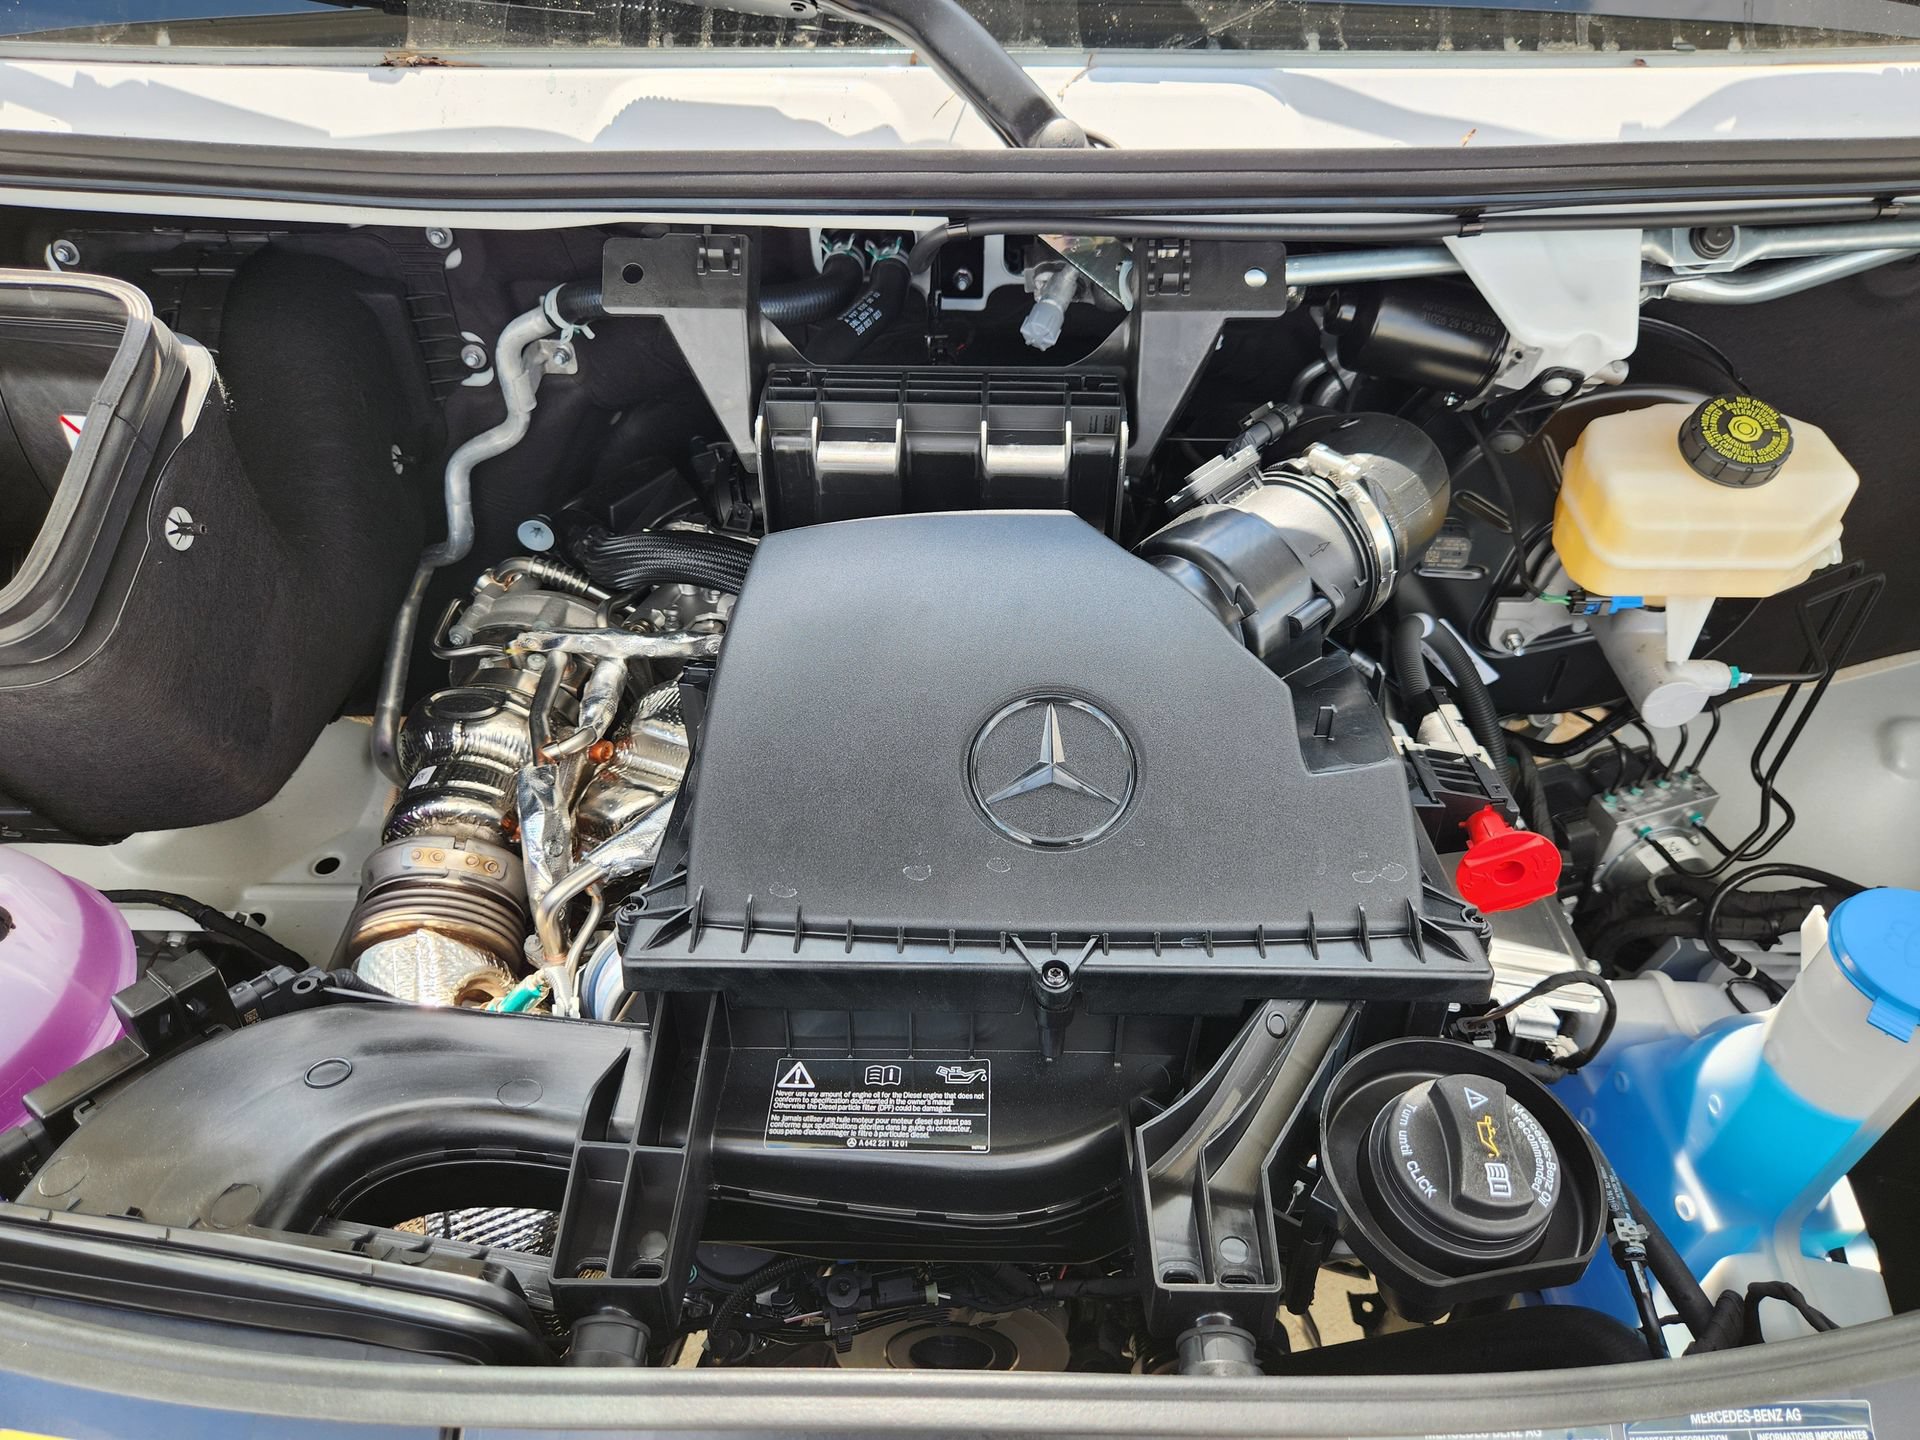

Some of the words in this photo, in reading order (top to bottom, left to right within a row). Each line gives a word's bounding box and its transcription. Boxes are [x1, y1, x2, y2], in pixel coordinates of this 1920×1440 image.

[1752, 399, 1780, 420] ORIGINAL
[1720, 440, 1733, 450] CAP
[1715, 445, 1734, 459] FLUID
[1757, 451, 1780, 464] SEALED
[810, 1097, 849, 1105] specification
[850, 1097, 889, 1105] documented
[923, 1092, 943, 1100] engine
[957, 1092, 973, 1100] does
[838, 1104, 861, 1112] particle
[1399, 1103, 1418, 1126] Turn
[785, 1128, 802, 1136] peine
[879, 1131, 909, 1139] particules
[908, 1125, 925, 1133] guide
[935, 1125, 972, 1133] conducteur,
[864, 1140, 877, 1148] 642
[891, 1140, 899, 1148] 12
[899, 1140, 908, 1148] 01
[1398, 1130, 1413, 1156] until
[1511, 1103, 1557, 1192] Mercedes-Benz
[1538, 1191, 1551, 1208] Oil
[1513, 1116, 1546, 1194] recommended
[1406, 1160, 1438, 1199] CLICK
[1690, 1408, 1783, 1425] MERCEDES-BENZ
[1785, 1407, 1802, 1422] AG
[1757, 1431, 1814, 1440] INFORMATIONS
[1815, 1430, 1869, 1440] IMPORTANTES
